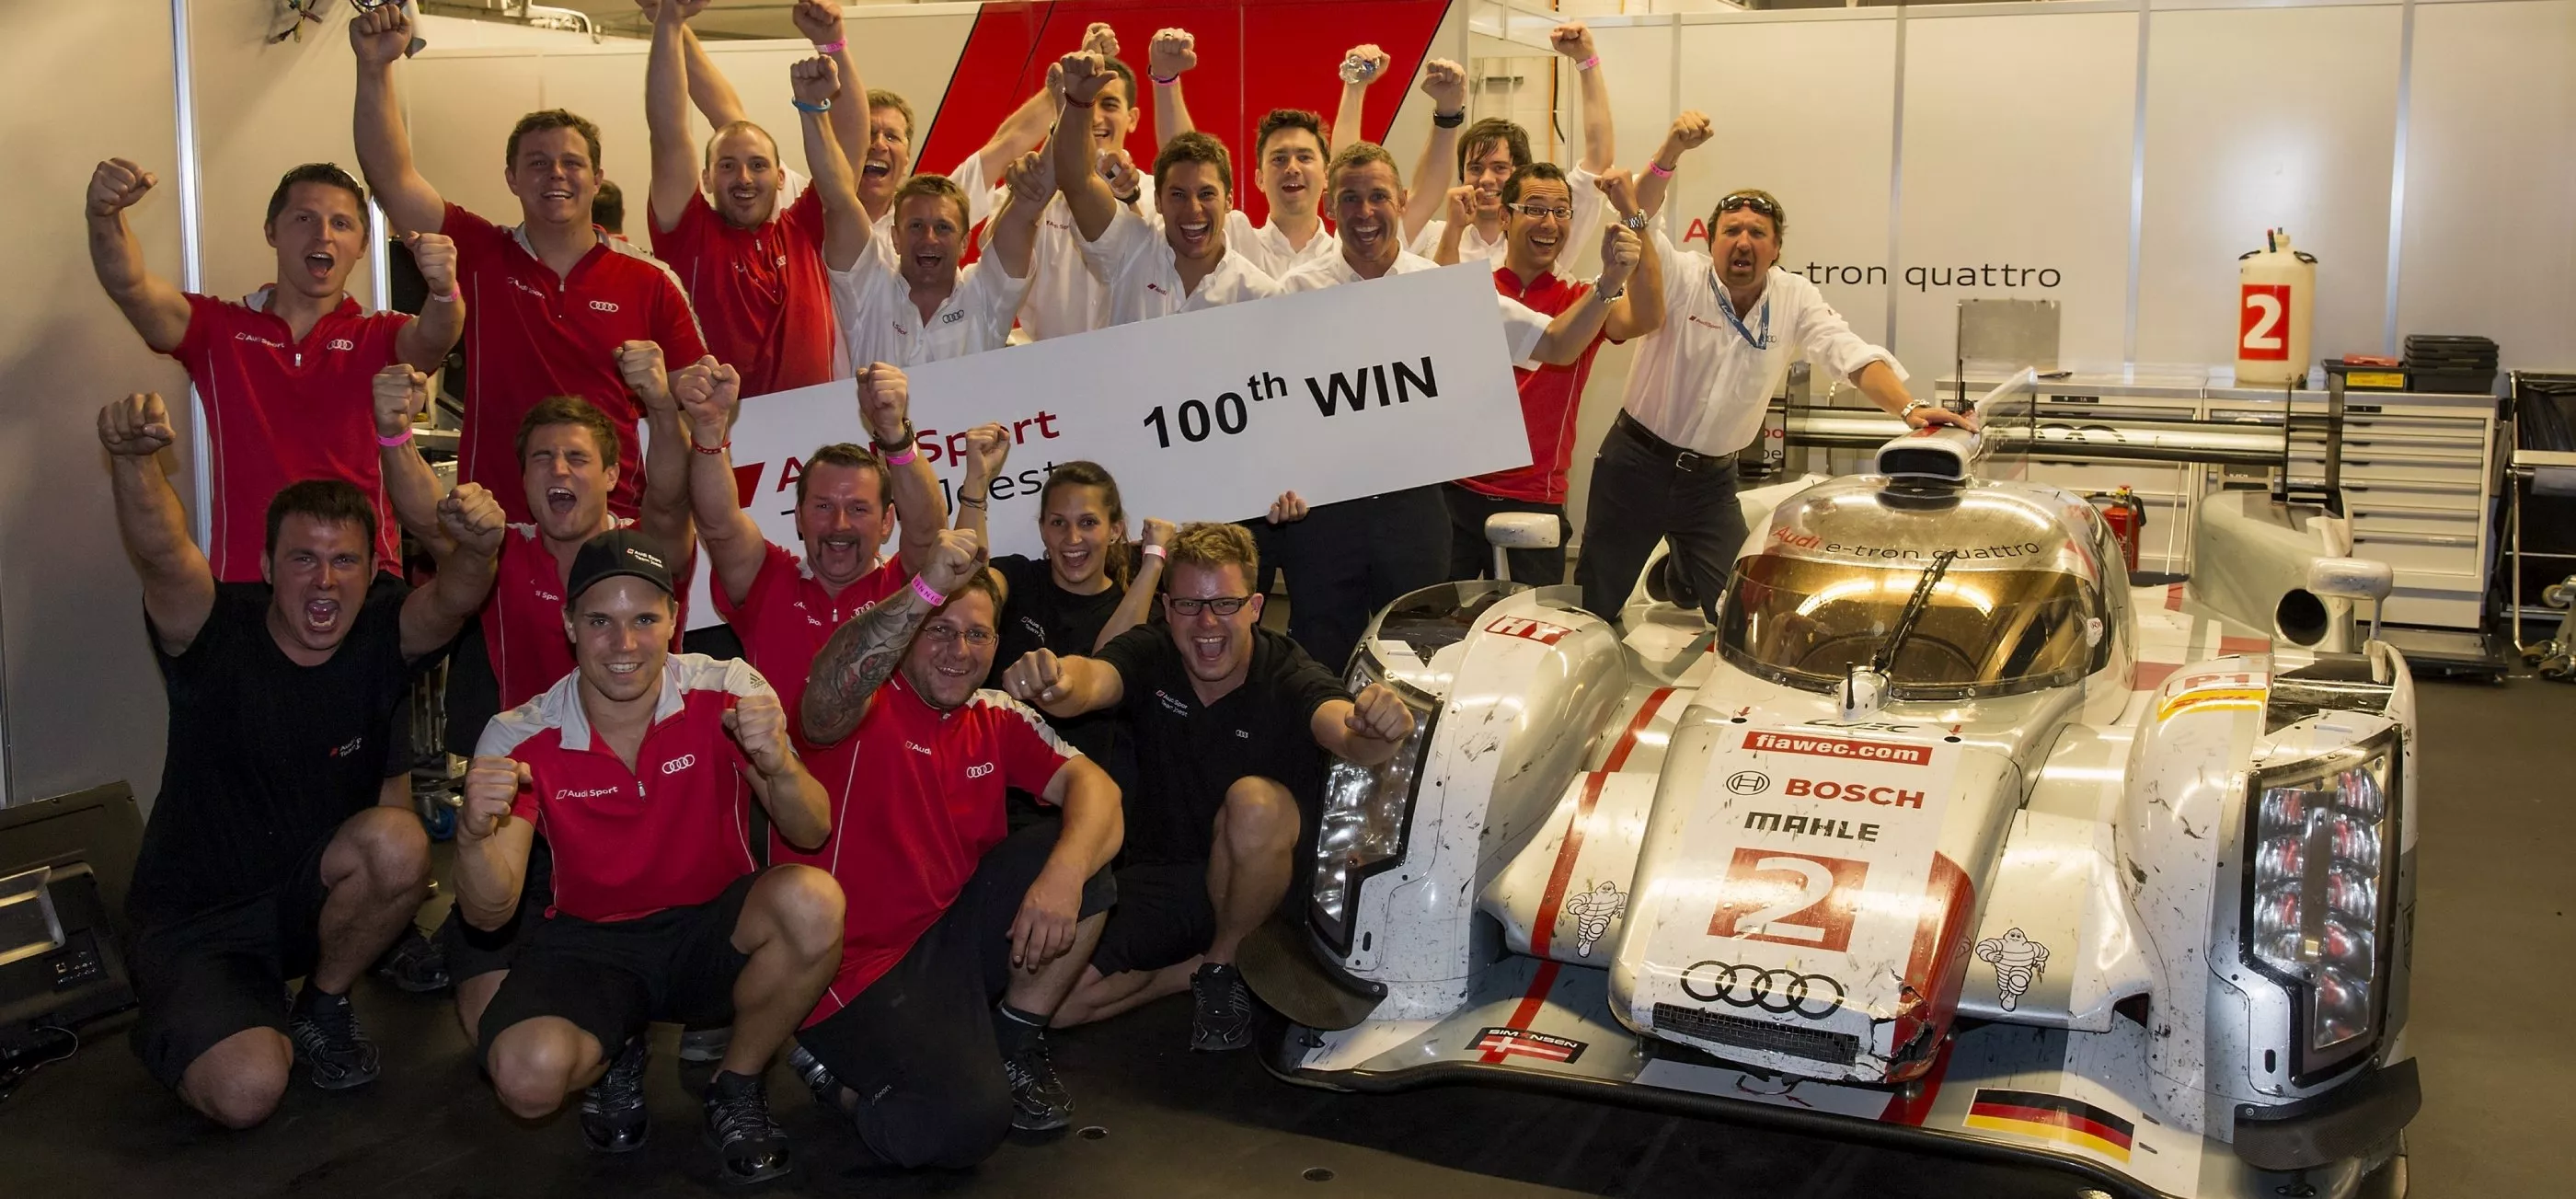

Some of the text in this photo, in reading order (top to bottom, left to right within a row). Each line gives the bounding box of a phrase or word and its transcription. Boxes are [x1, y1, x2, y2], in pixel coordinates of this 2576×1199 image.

[1778, 260, 2062, 292] -tron quattro
[2243, 294, 2283, 350] 2
[1304, 356, 1439, 418] WIN
[915, 409, 1060, 467] Sprt
[1772, 525, 1823, 550] Audi
[1825, 542, 1920, 559] e-tron
[1489, 615, 1571, 644] HY
[1756, 734, 1920, 762] fiawec.com
[568, 786, 618, 798] Audi Sport
[1785, 778, 1926, 810] BOSCH
[1744, 812, 1880, 843] MAHLE
[1733, 857, 1834, 943] 2
